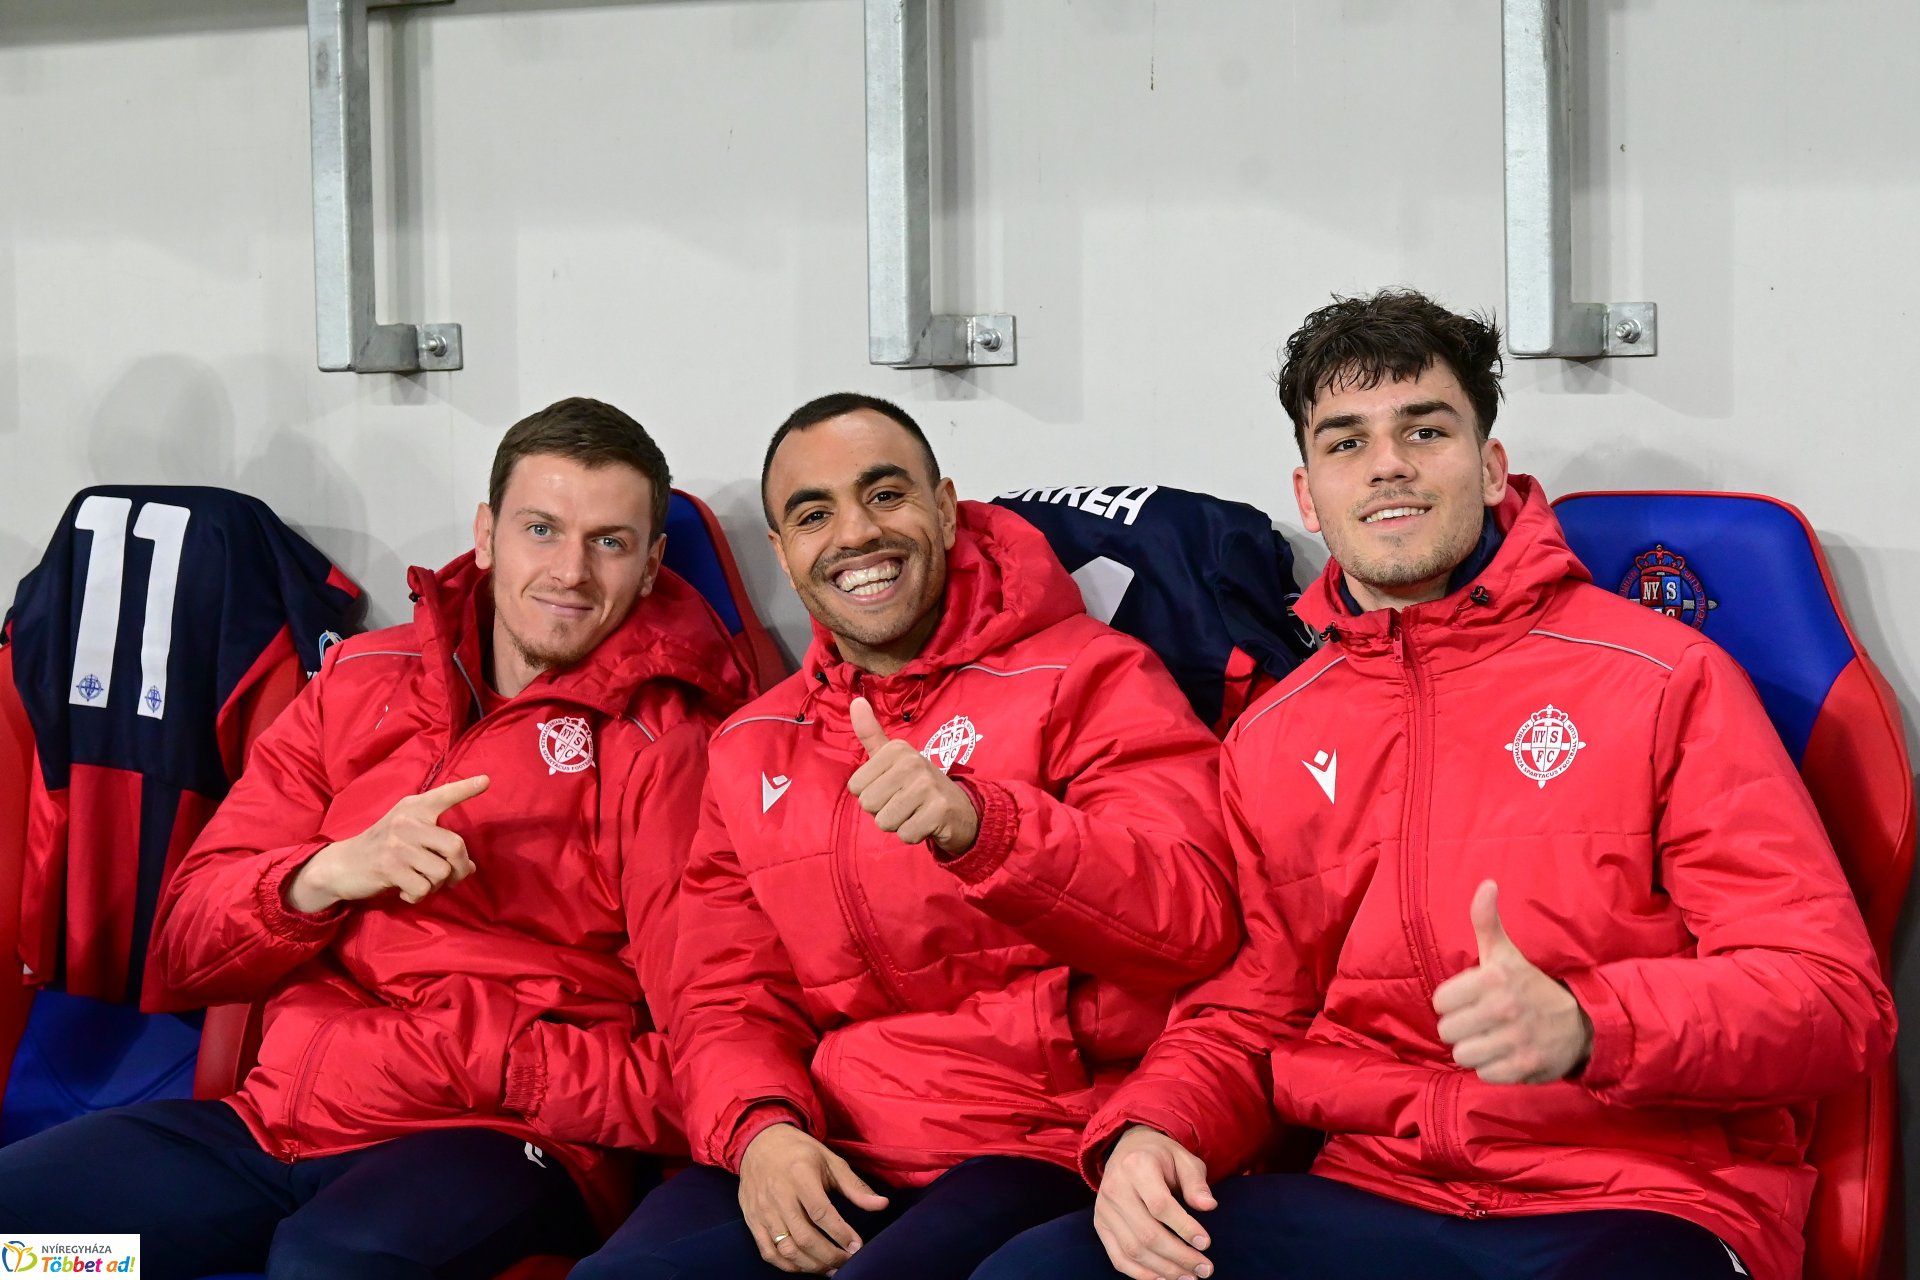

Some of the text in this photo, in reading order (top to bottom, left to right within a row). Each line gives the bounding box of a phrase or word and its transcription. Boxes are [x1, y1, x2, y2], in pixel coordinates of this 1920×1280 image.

[1642, 581, 1660, 601] NY
[1666, 581, 1677, 601] S
[69, 495, 191, 720] 11
[561, 728, 574, 740] NY
[1533, 730, 1559, 743] NY S
[1536, 750, 1555, 763] F C
